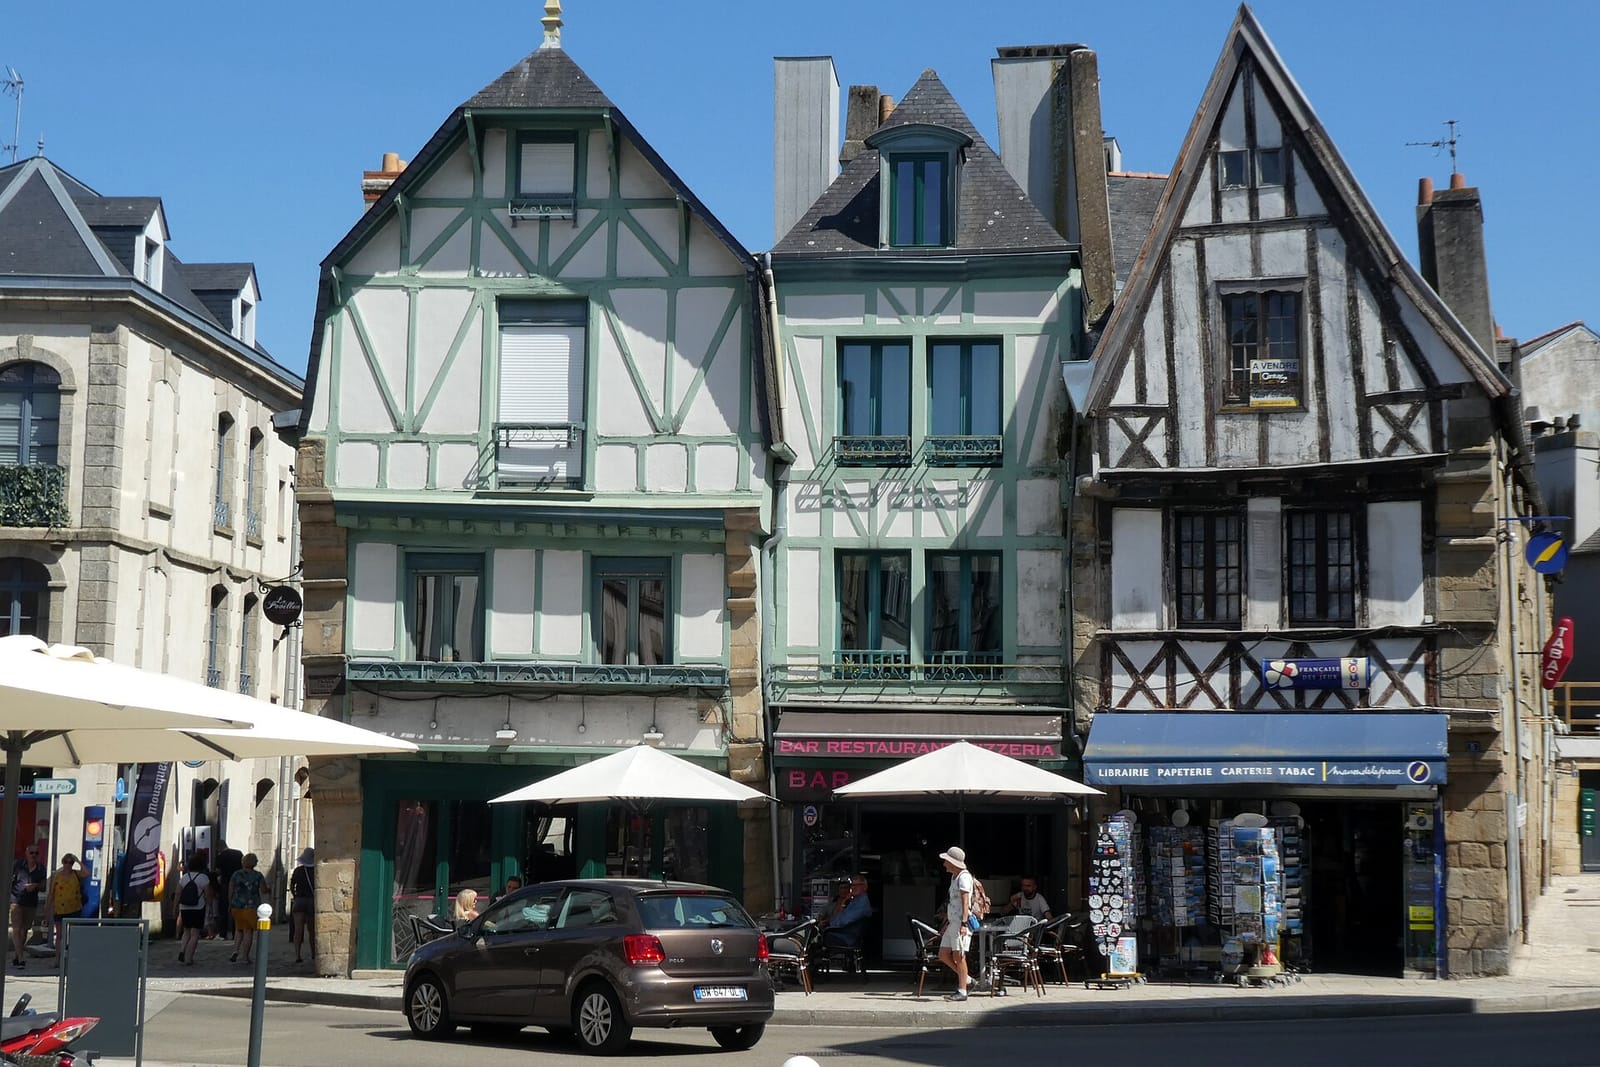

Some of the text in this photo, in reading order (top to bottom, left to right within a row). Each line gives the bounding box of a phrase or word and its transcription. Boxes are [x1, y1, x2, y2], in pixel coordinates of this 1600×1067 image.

[1545, 626, 1568, 681] TABAC
[780, 741, 819, 753] BAR
[826, 741, 951, 754] RESTAURAN
[788, 770, 850, 789] BAR
[1099, 768, 1149, 777] LIBRAIRIE
[1157, 767, 1213, 777] PAPETERIE
[1220, 767, 1273, 776] CARTERIE
[1279, 767, 1316, 776] TABAC
